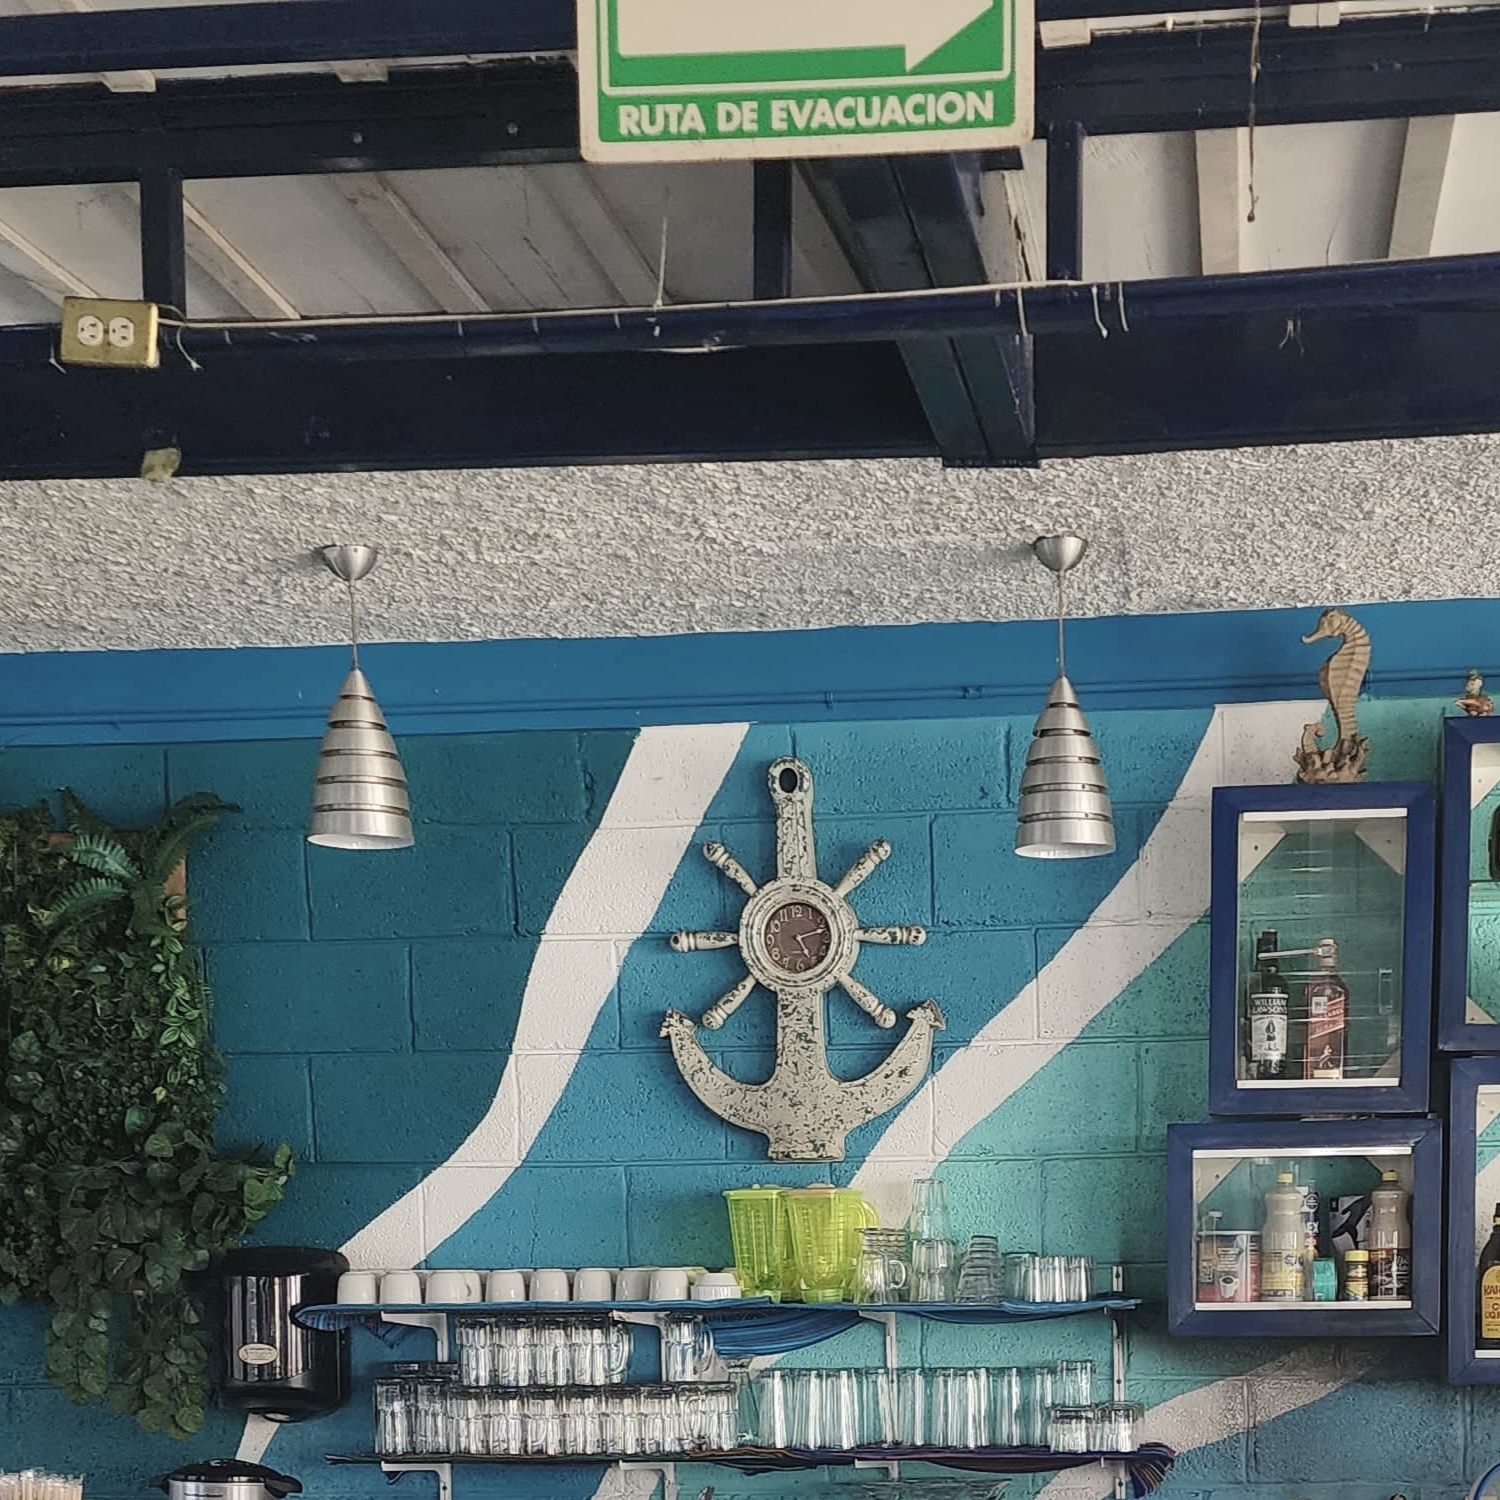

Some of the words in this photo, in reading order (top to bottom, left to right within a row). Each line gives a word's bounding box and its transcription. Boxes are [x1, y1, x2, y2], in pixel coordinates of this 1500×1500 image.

[618, 103, 705, 136] RUTA
[716, 101, 758, 132] DE
[770, 90, 994, 131] EVACUACION
